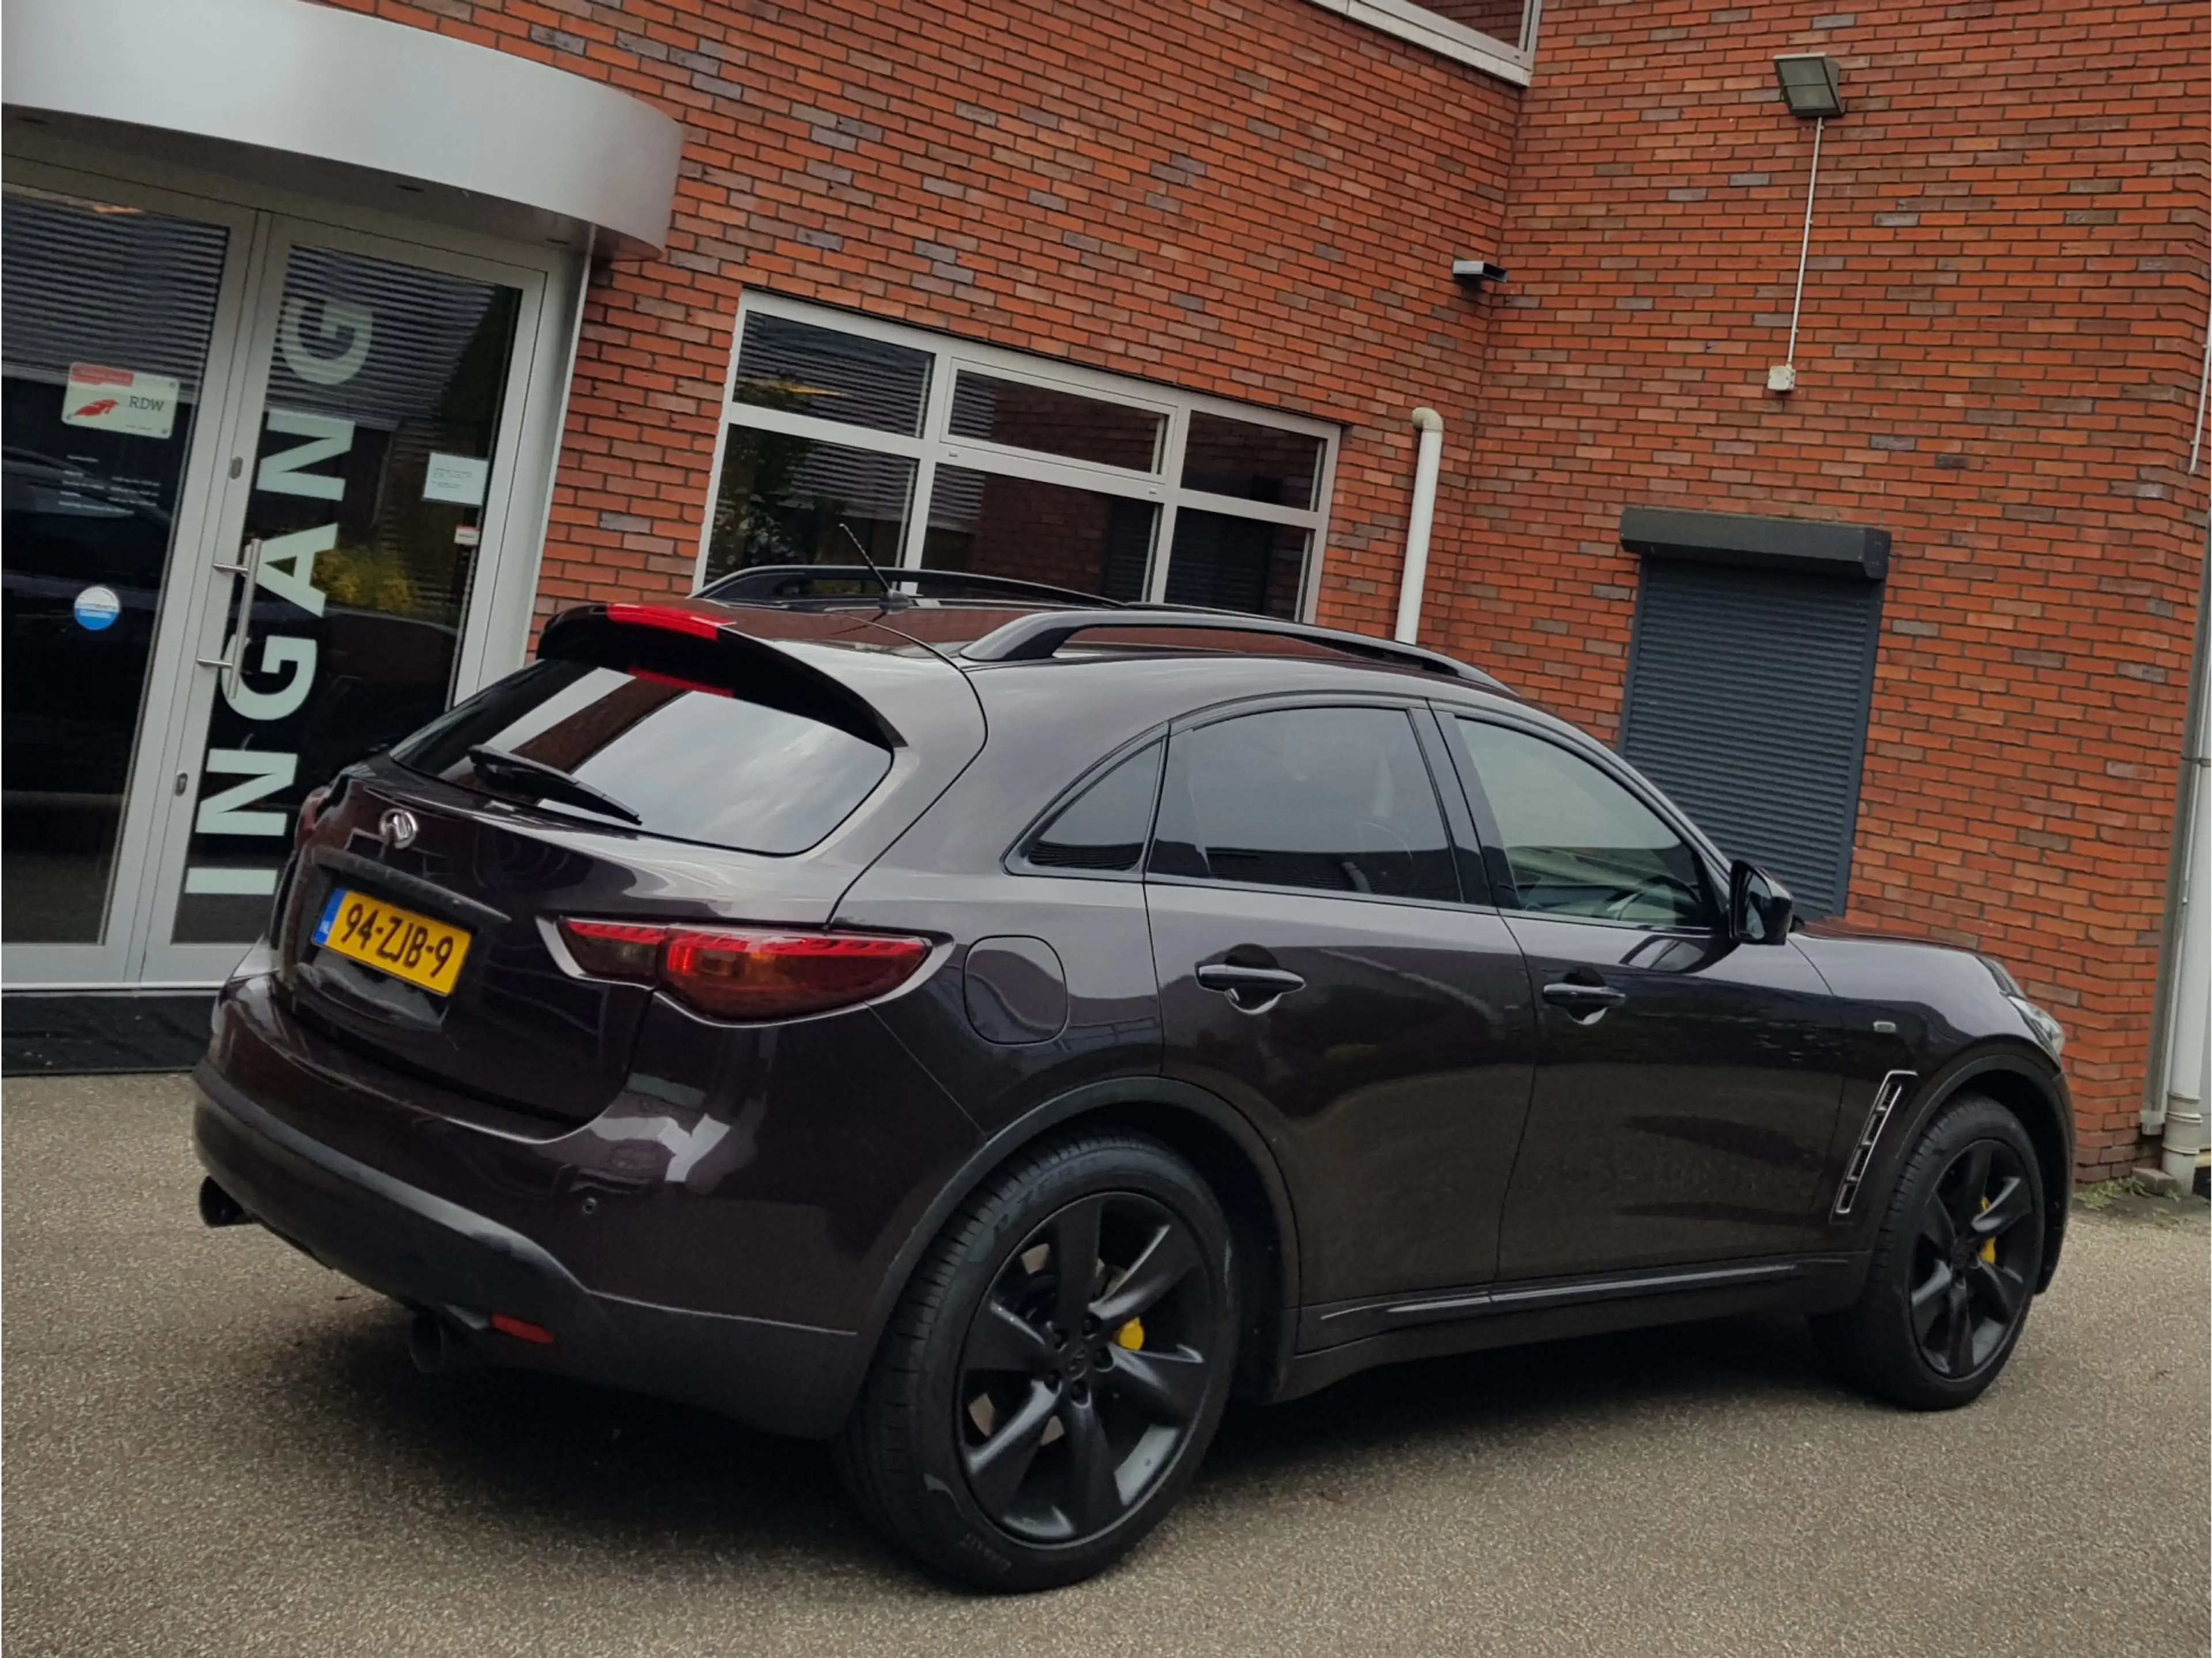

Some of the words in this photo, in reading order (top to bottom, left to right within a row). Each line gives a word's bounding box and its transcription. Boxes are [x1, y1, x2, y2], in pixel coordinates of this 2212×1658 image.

[128, 395, 165, 412] RDW
[184, 296, 373, 895] INGANG
[340, 903, 454, 979] 94-ZJB-9
